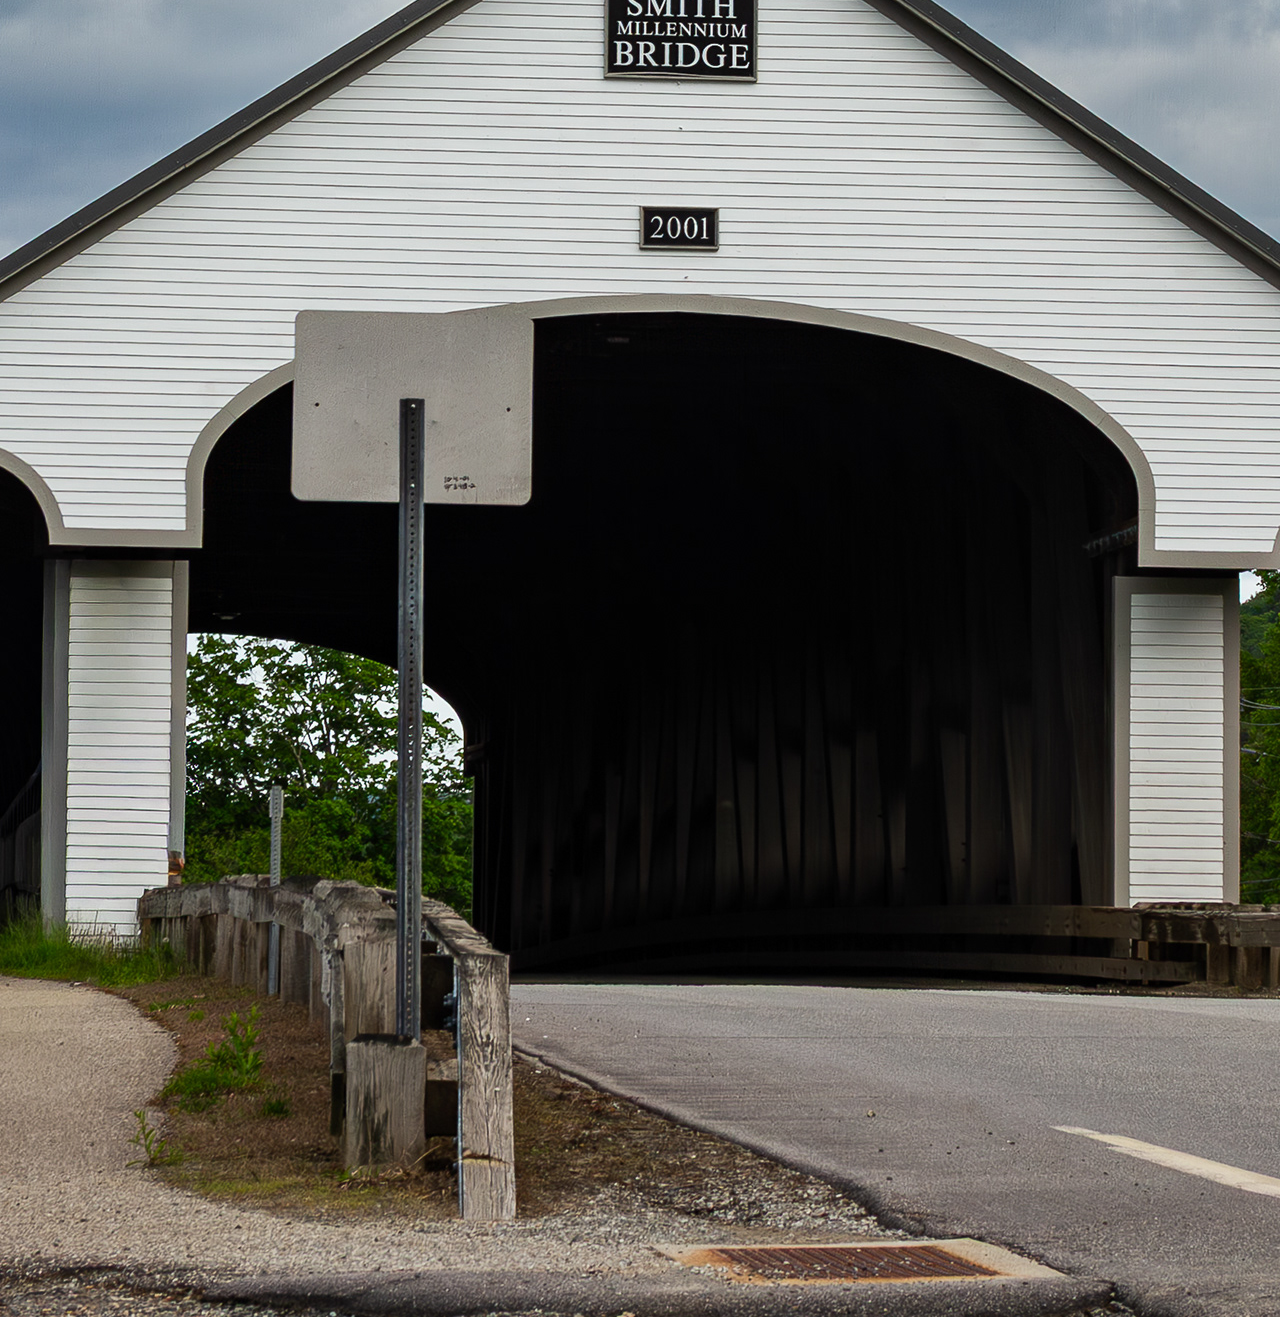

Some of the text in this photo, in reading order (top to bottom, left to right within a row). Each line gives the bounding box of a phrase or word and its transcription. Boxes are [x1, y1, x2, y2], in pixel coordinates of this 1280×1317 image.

[616, 20, 747, 39] MILLENNIUM
[613, 40, 750, 69] BRIDGE
[650, 215, 709, 240] 2001
